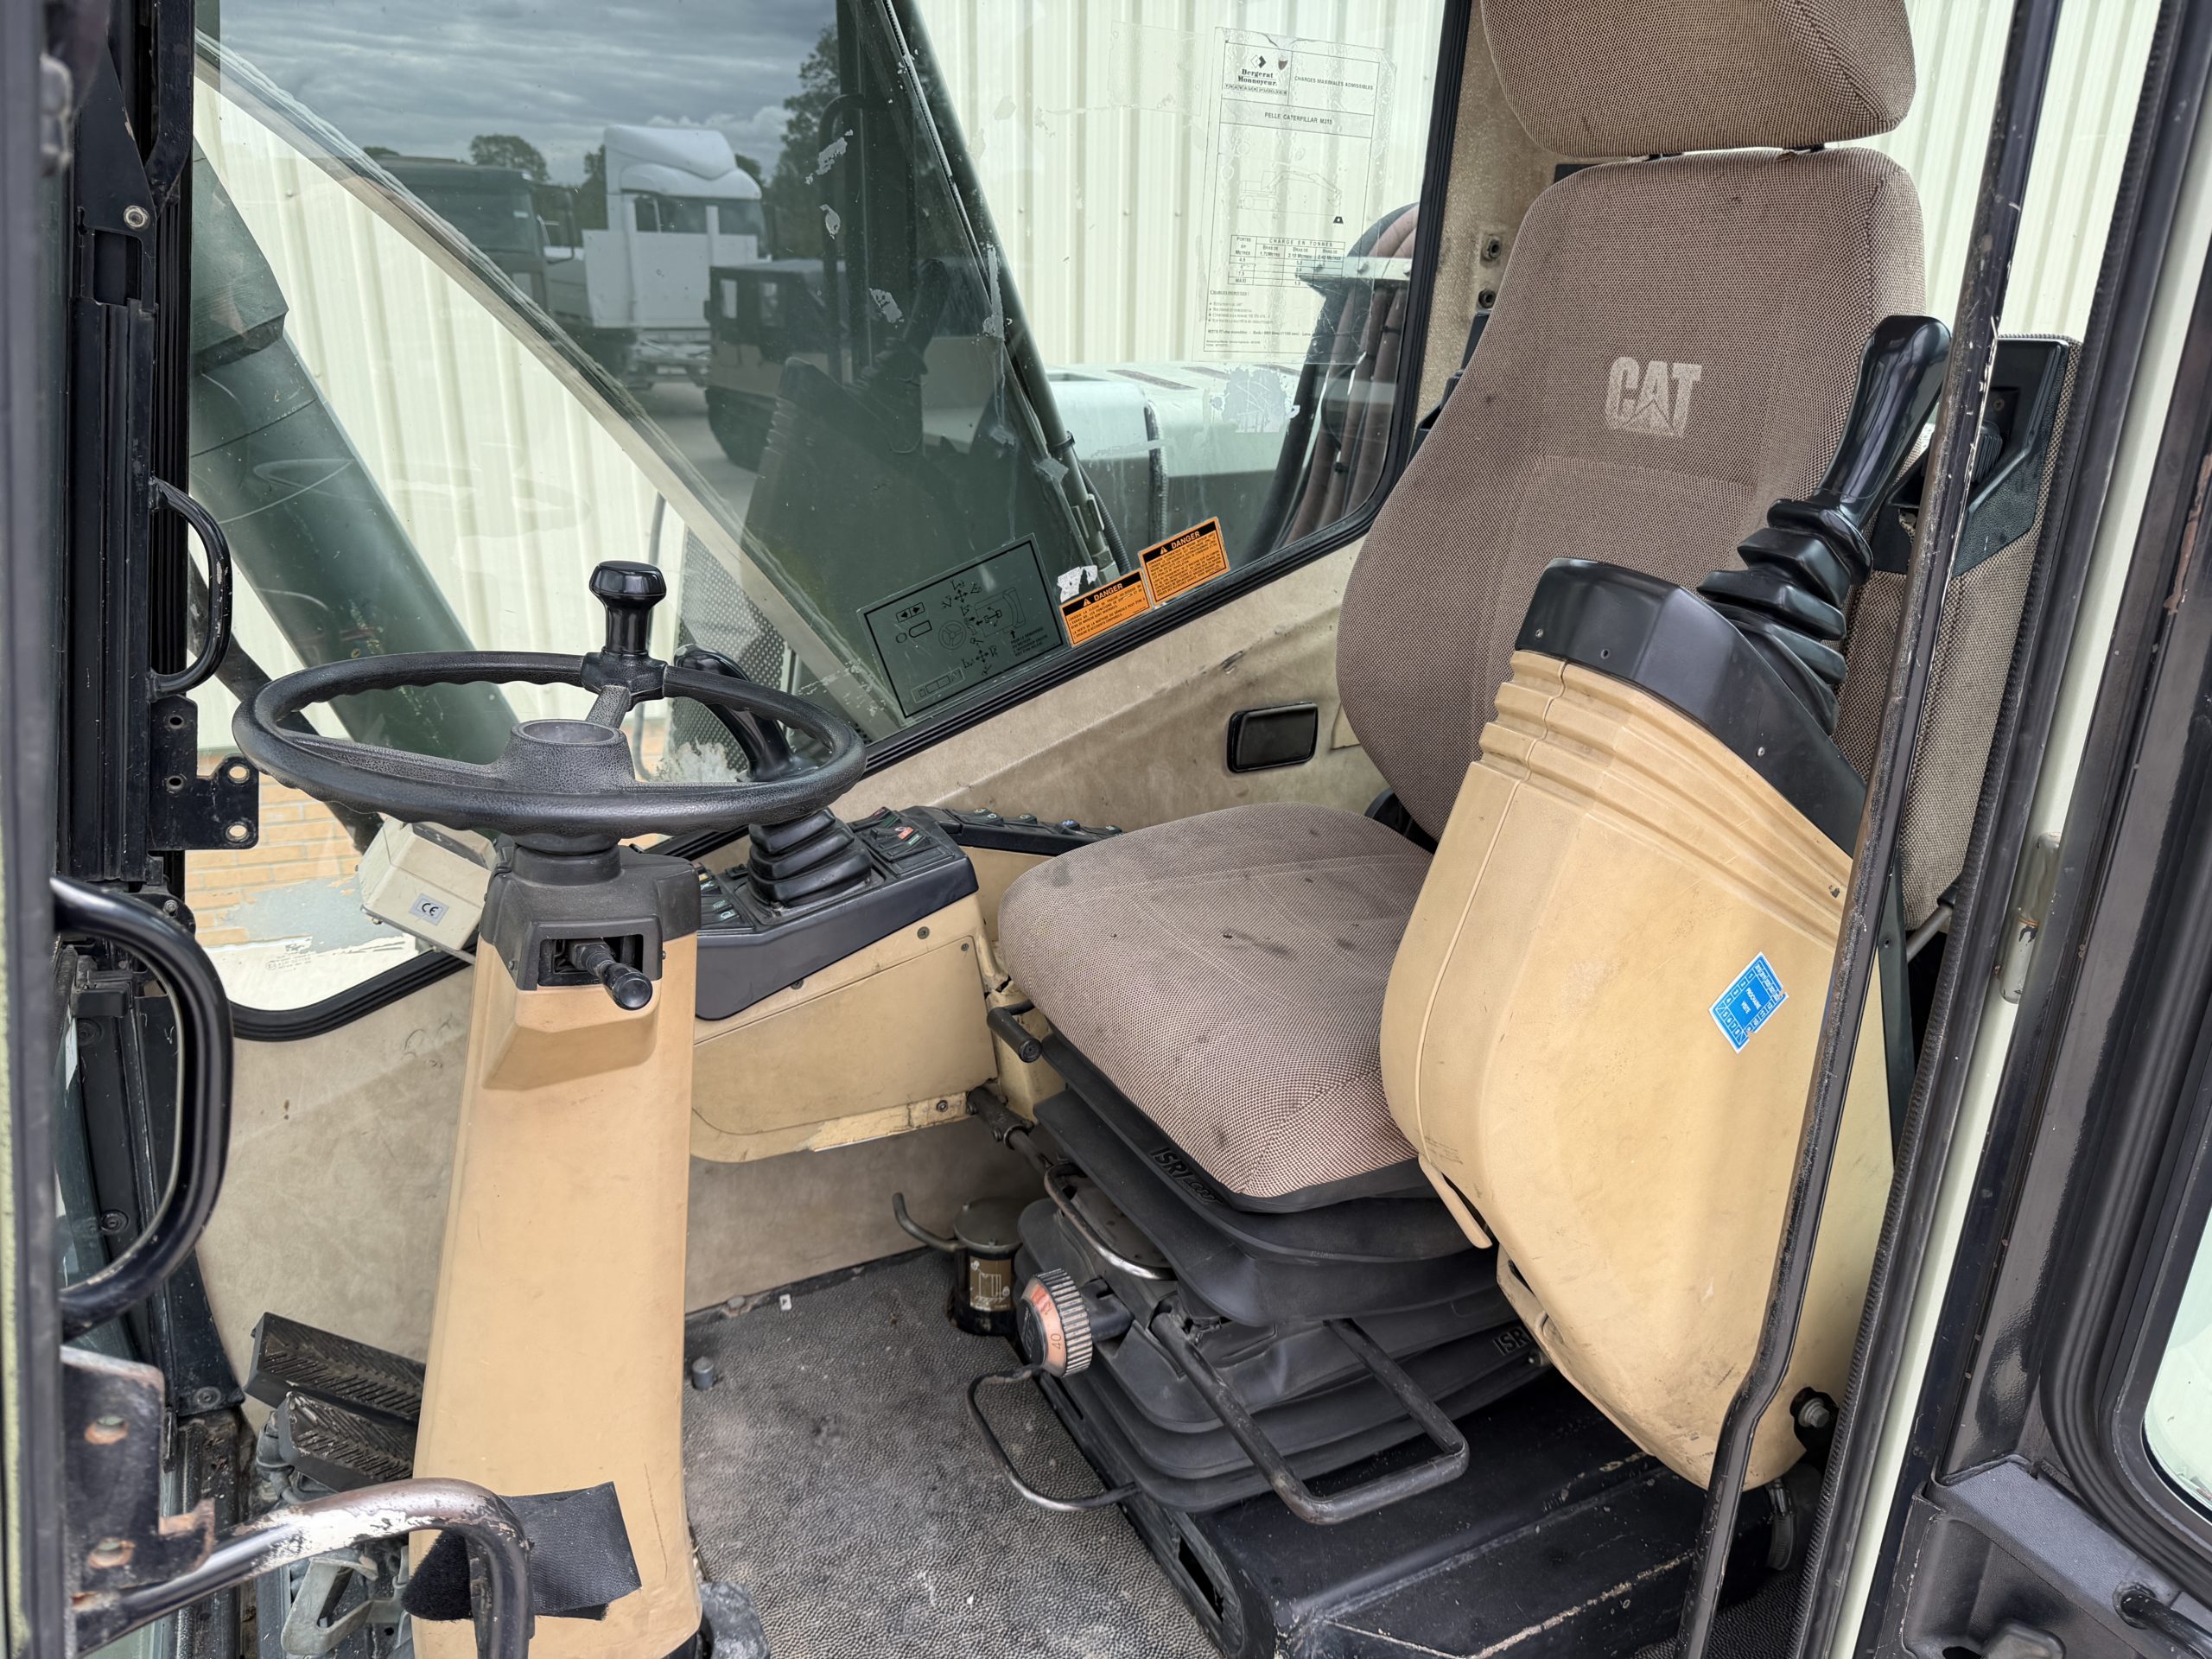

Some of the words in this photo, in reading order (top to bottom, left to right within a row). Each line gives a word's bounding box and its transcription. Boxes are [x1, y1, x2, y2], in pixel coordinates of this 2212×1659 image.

[1242, 69, 1274, 78] Bergerat
[1344, 82, 1374, 91] ADMISSIBLES
[1264, 111, 1281, 120] PELLE
[1283, 113, 1318, 124] CATERPILLAR
[1605, 356, 1702, 436] CAT
[1170, 531, 1200, 549] DANGER
[1093, 582, 1122, 601] DANGER
[422, 903, 439, 916] CE
[1150, 1147, 1194, 1179] ISRI
[1050, 1333, 1062, 1350] 40
